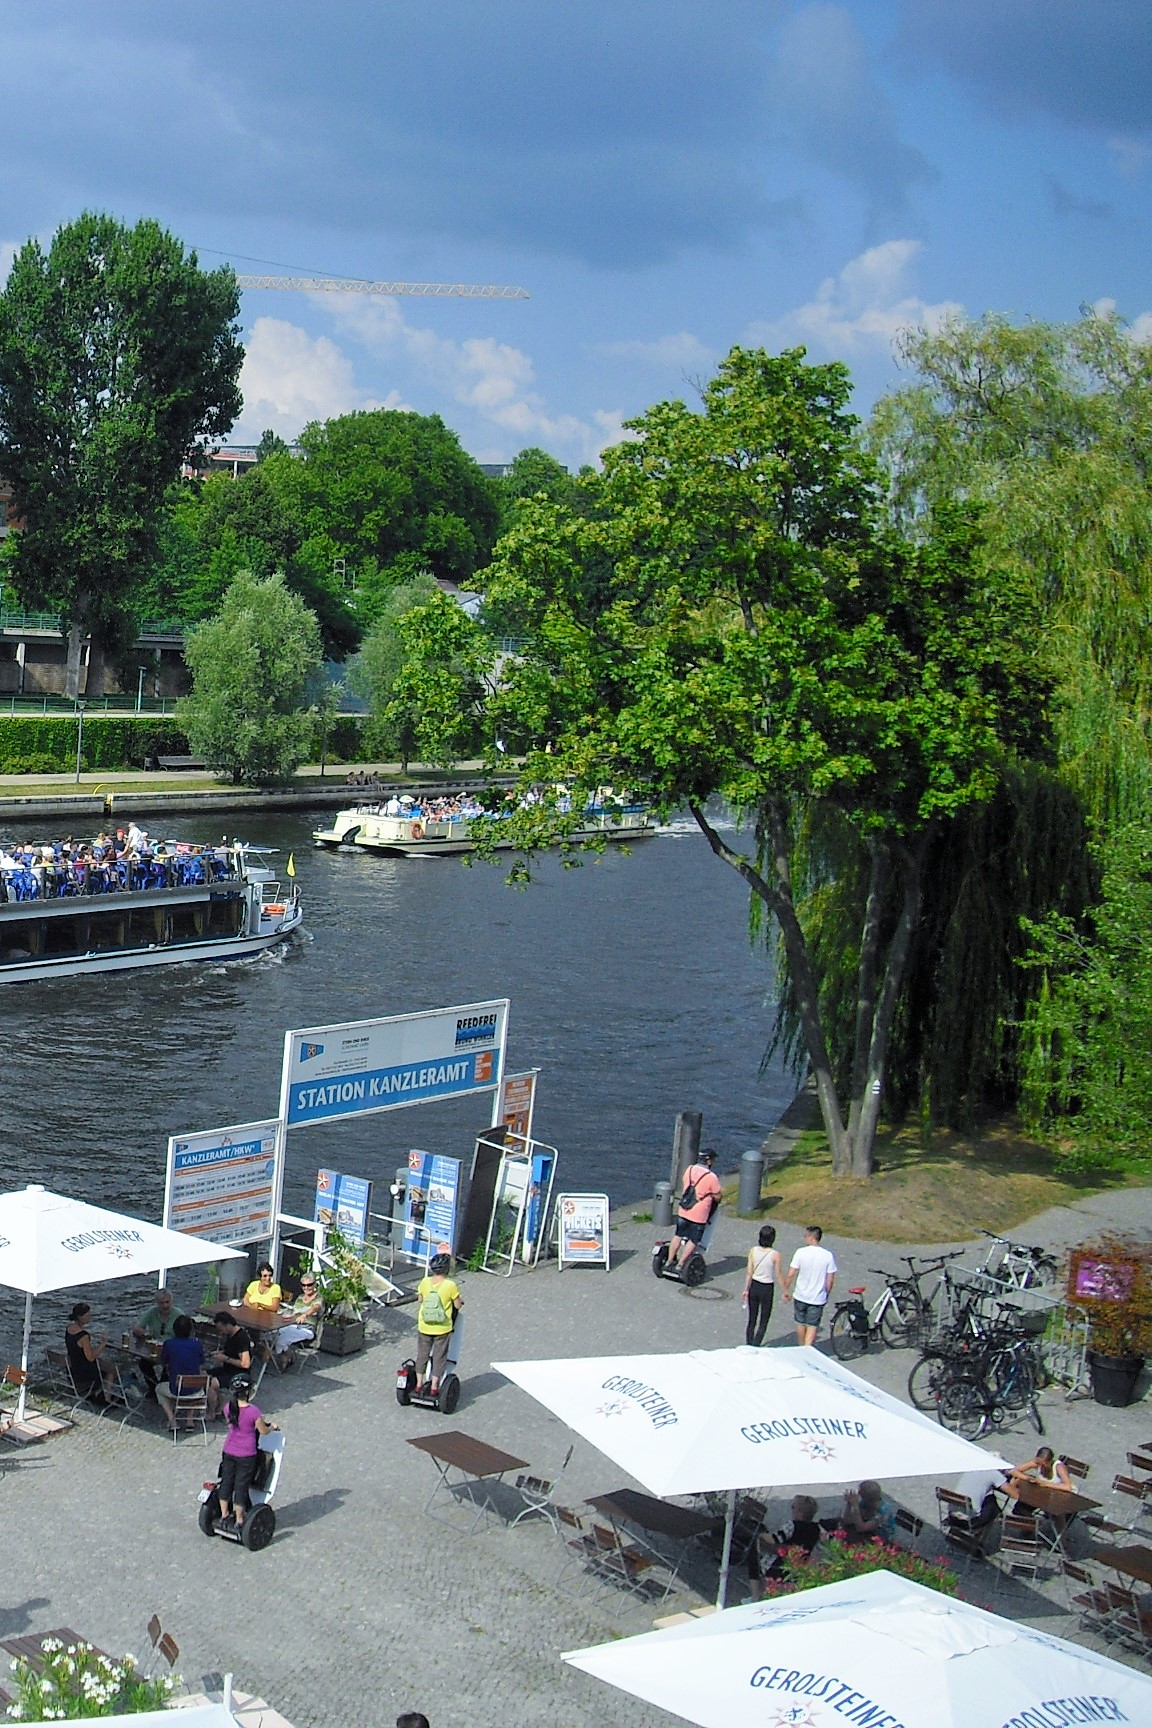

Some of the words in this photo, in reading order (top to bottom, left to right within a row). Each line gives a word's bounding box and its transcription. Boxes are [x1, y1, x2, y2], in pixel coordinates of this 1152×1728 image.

[297, 1080, 365, 1110] STATION
[369, 1061, 469, 1097] KANZLERAMT
[564, 1216, 602, 1229] TICKETS
[60, 1229, 145, 1252] GEROLSTEINER
[601, 1375, 679, 1430] GEROLSTEINER
[741, 1417, 868, 1444] GEROLSTEINER
